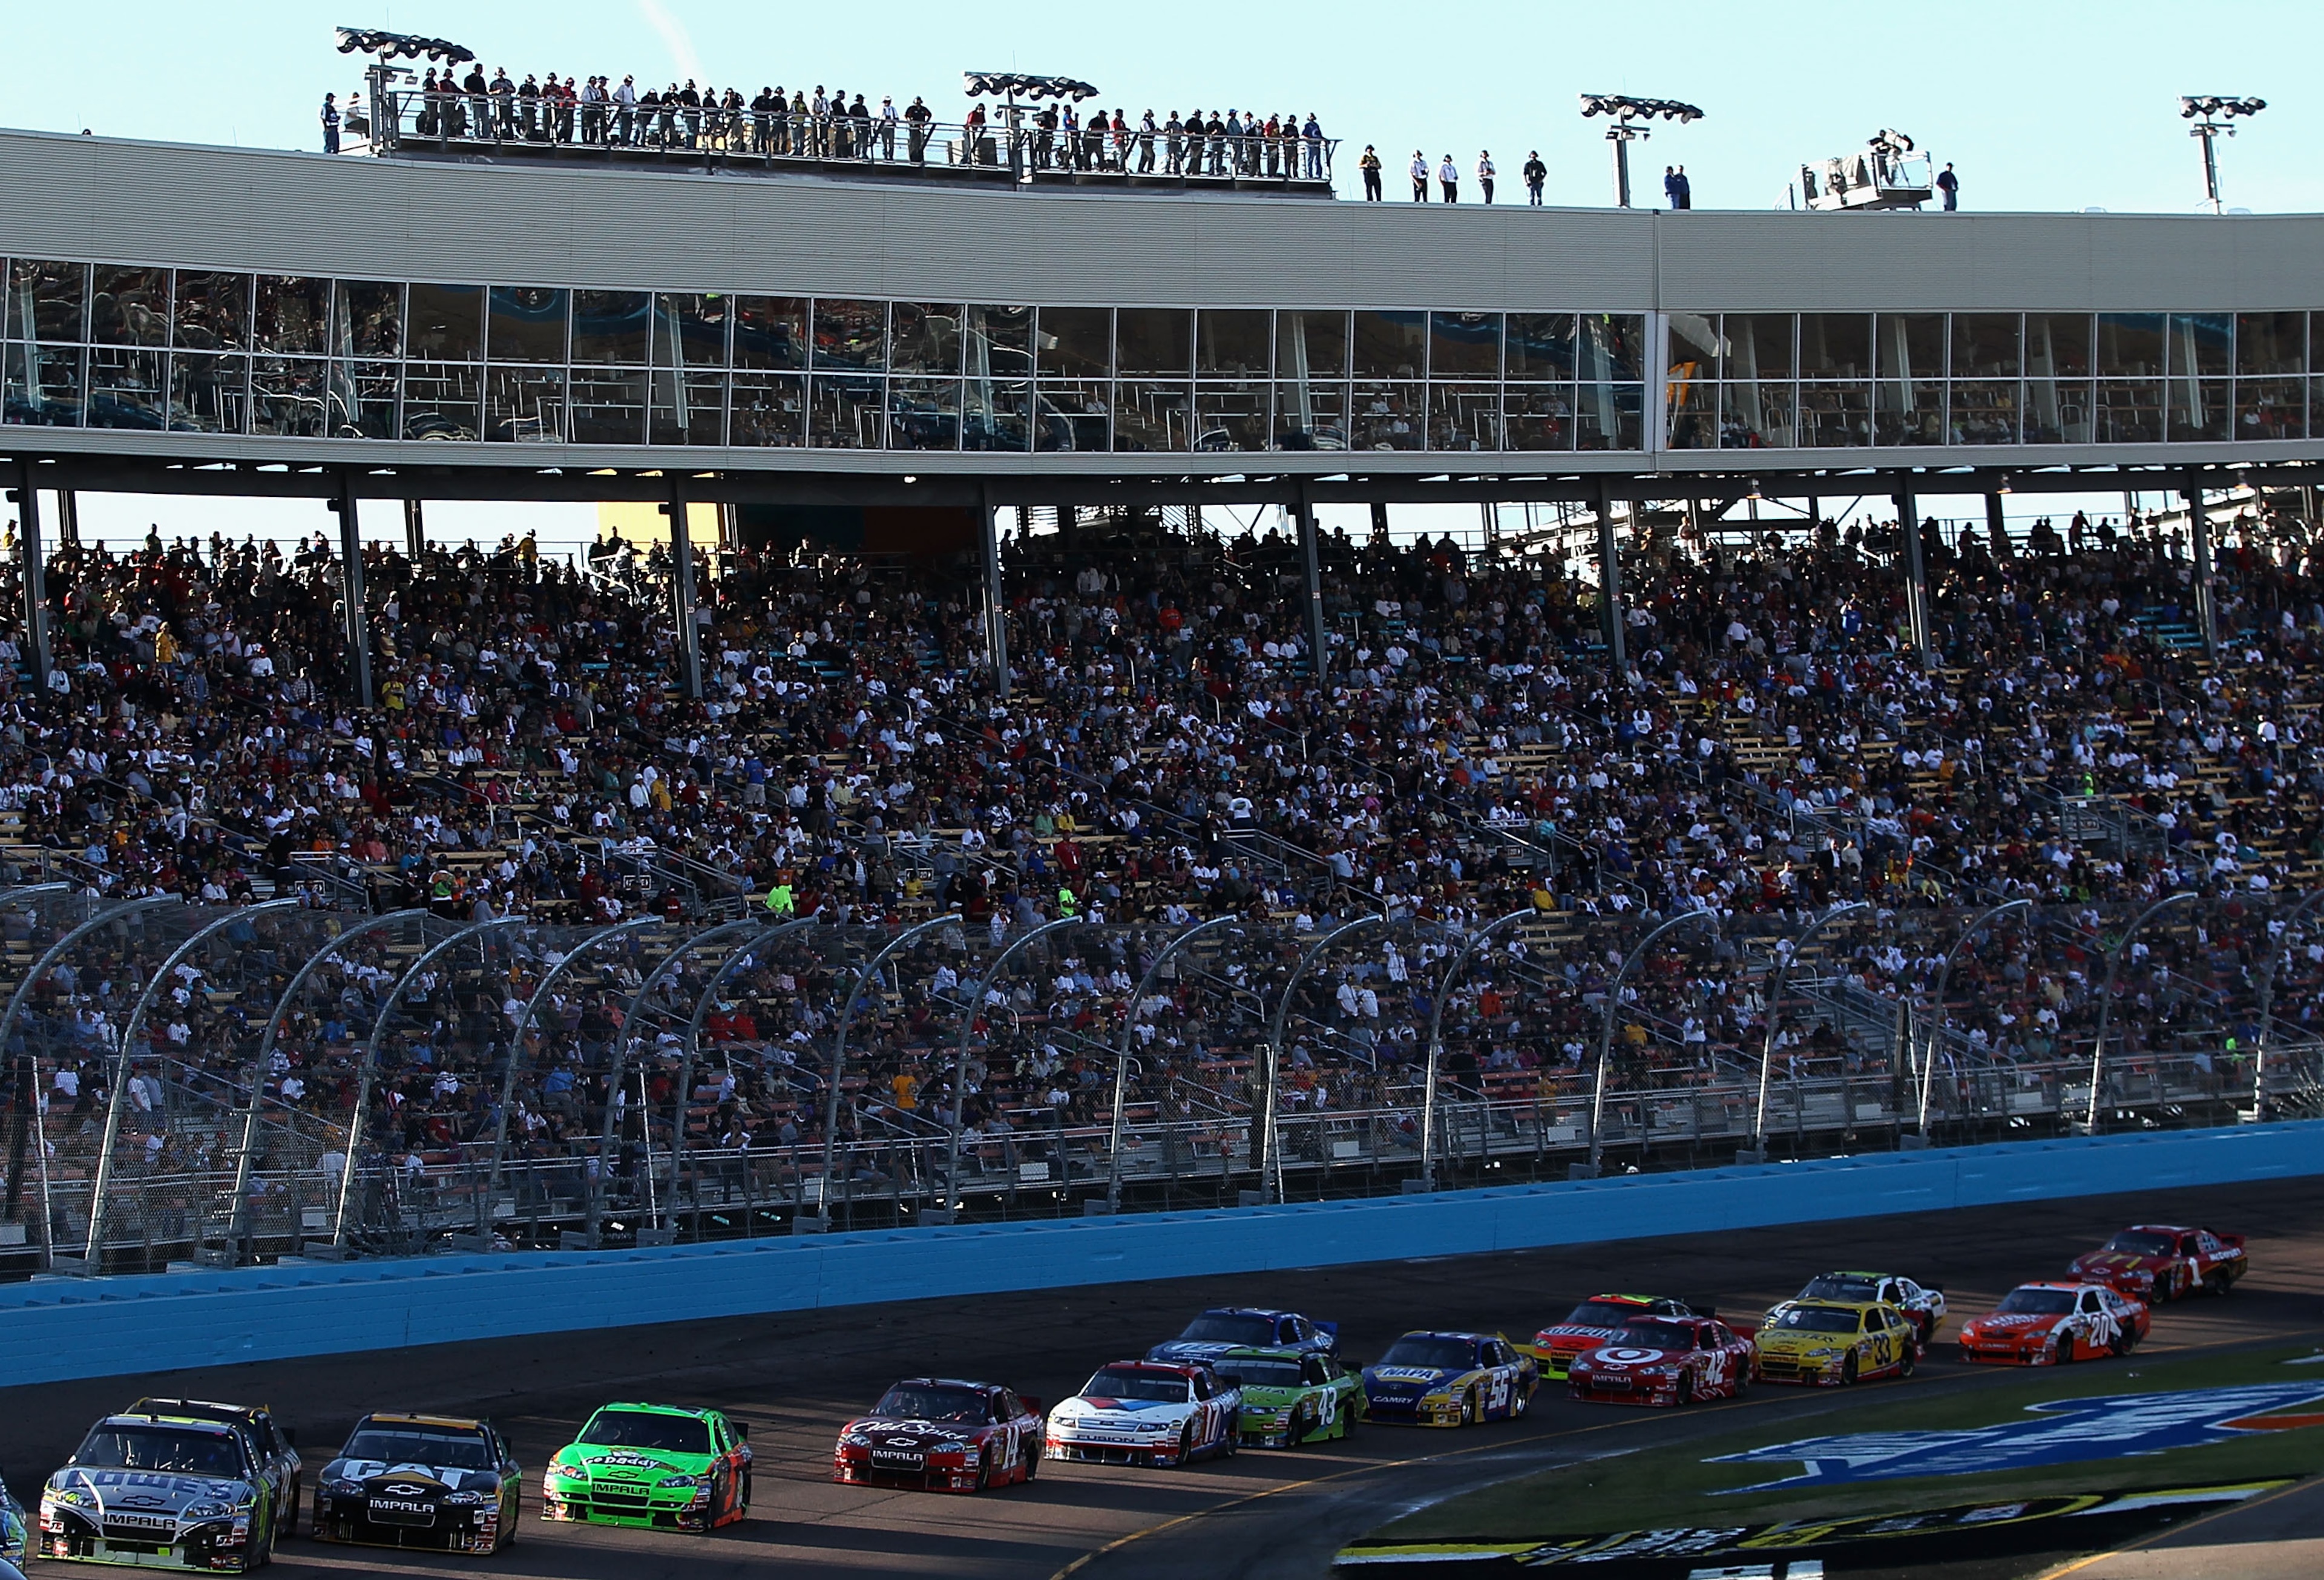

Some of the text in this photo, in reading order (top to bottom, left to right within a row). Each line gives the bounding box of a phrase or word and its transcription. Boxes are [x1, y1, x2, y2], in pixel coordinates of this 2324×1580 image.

[2189, 1257, 2204, 1287] 1
[2090, 1314, 2109, 1348] 20
[1873, 1333, 1891, 1365] 33
[1382, 1368, 1434, 1379] NAPA
[1592, 1374, 1632, 1383] IMPALA
[1705, 1350, 1726, 1386] 42
[1488, 1369, 1509, 1410] 56
[1318, 1386, 1338, 1426] 43
[850, 1421, 969, 1440] Old Spice
[1204, 1401, 1220, 1443] 17
[1002, 1424, 1020, 1470] 14
[1077, 1434, 1135, 1444] FUSION
[872, 1451, 924, 1461] IMPALA
[341, 1460, 475, 1490] CAT
[592, 1483, 650, 1495] IMPALA
[103, 1513, 176, 1529] IMPALA
[370, 1500, 435, 1513] IMPALA
